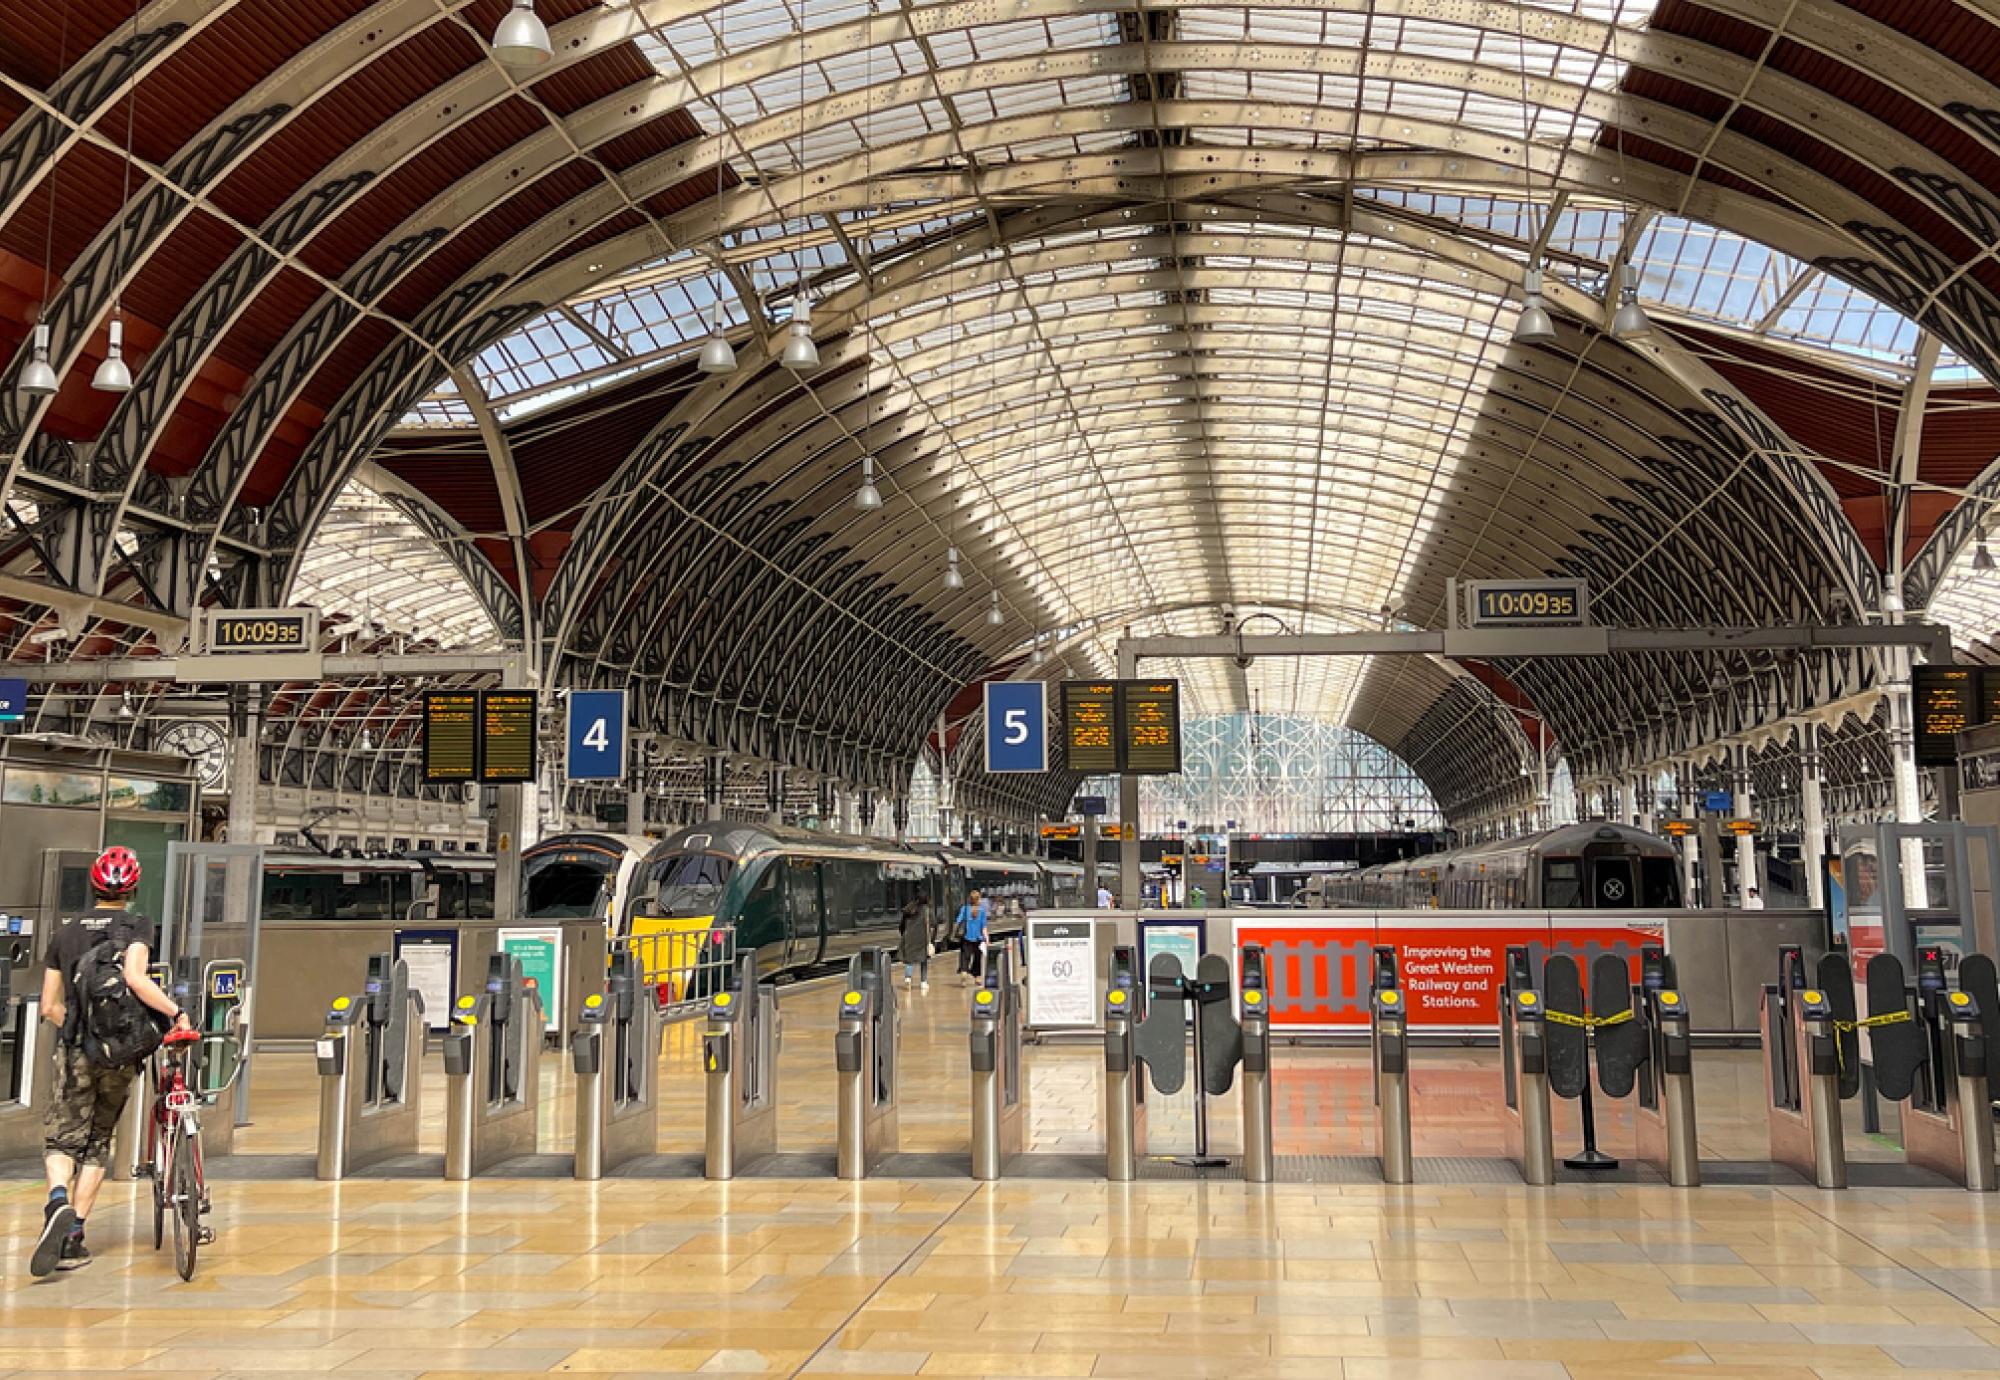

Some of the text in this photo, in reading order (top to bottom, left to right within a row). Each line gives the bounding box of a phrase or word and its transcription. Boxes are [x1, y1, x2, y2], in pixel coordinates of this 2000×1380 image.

[582, 718, 609, 752] 4
[1004, 709, 1028, 746] 5
[1403, 946, 1491, 960] Improving the
[1051, 960, 1073, 979] 60
[1405, 962, 1493, 975] Great Western
[1408, 978, 1489, 994] Railway and
[1422, 995, 1479, 1008] Stations.
